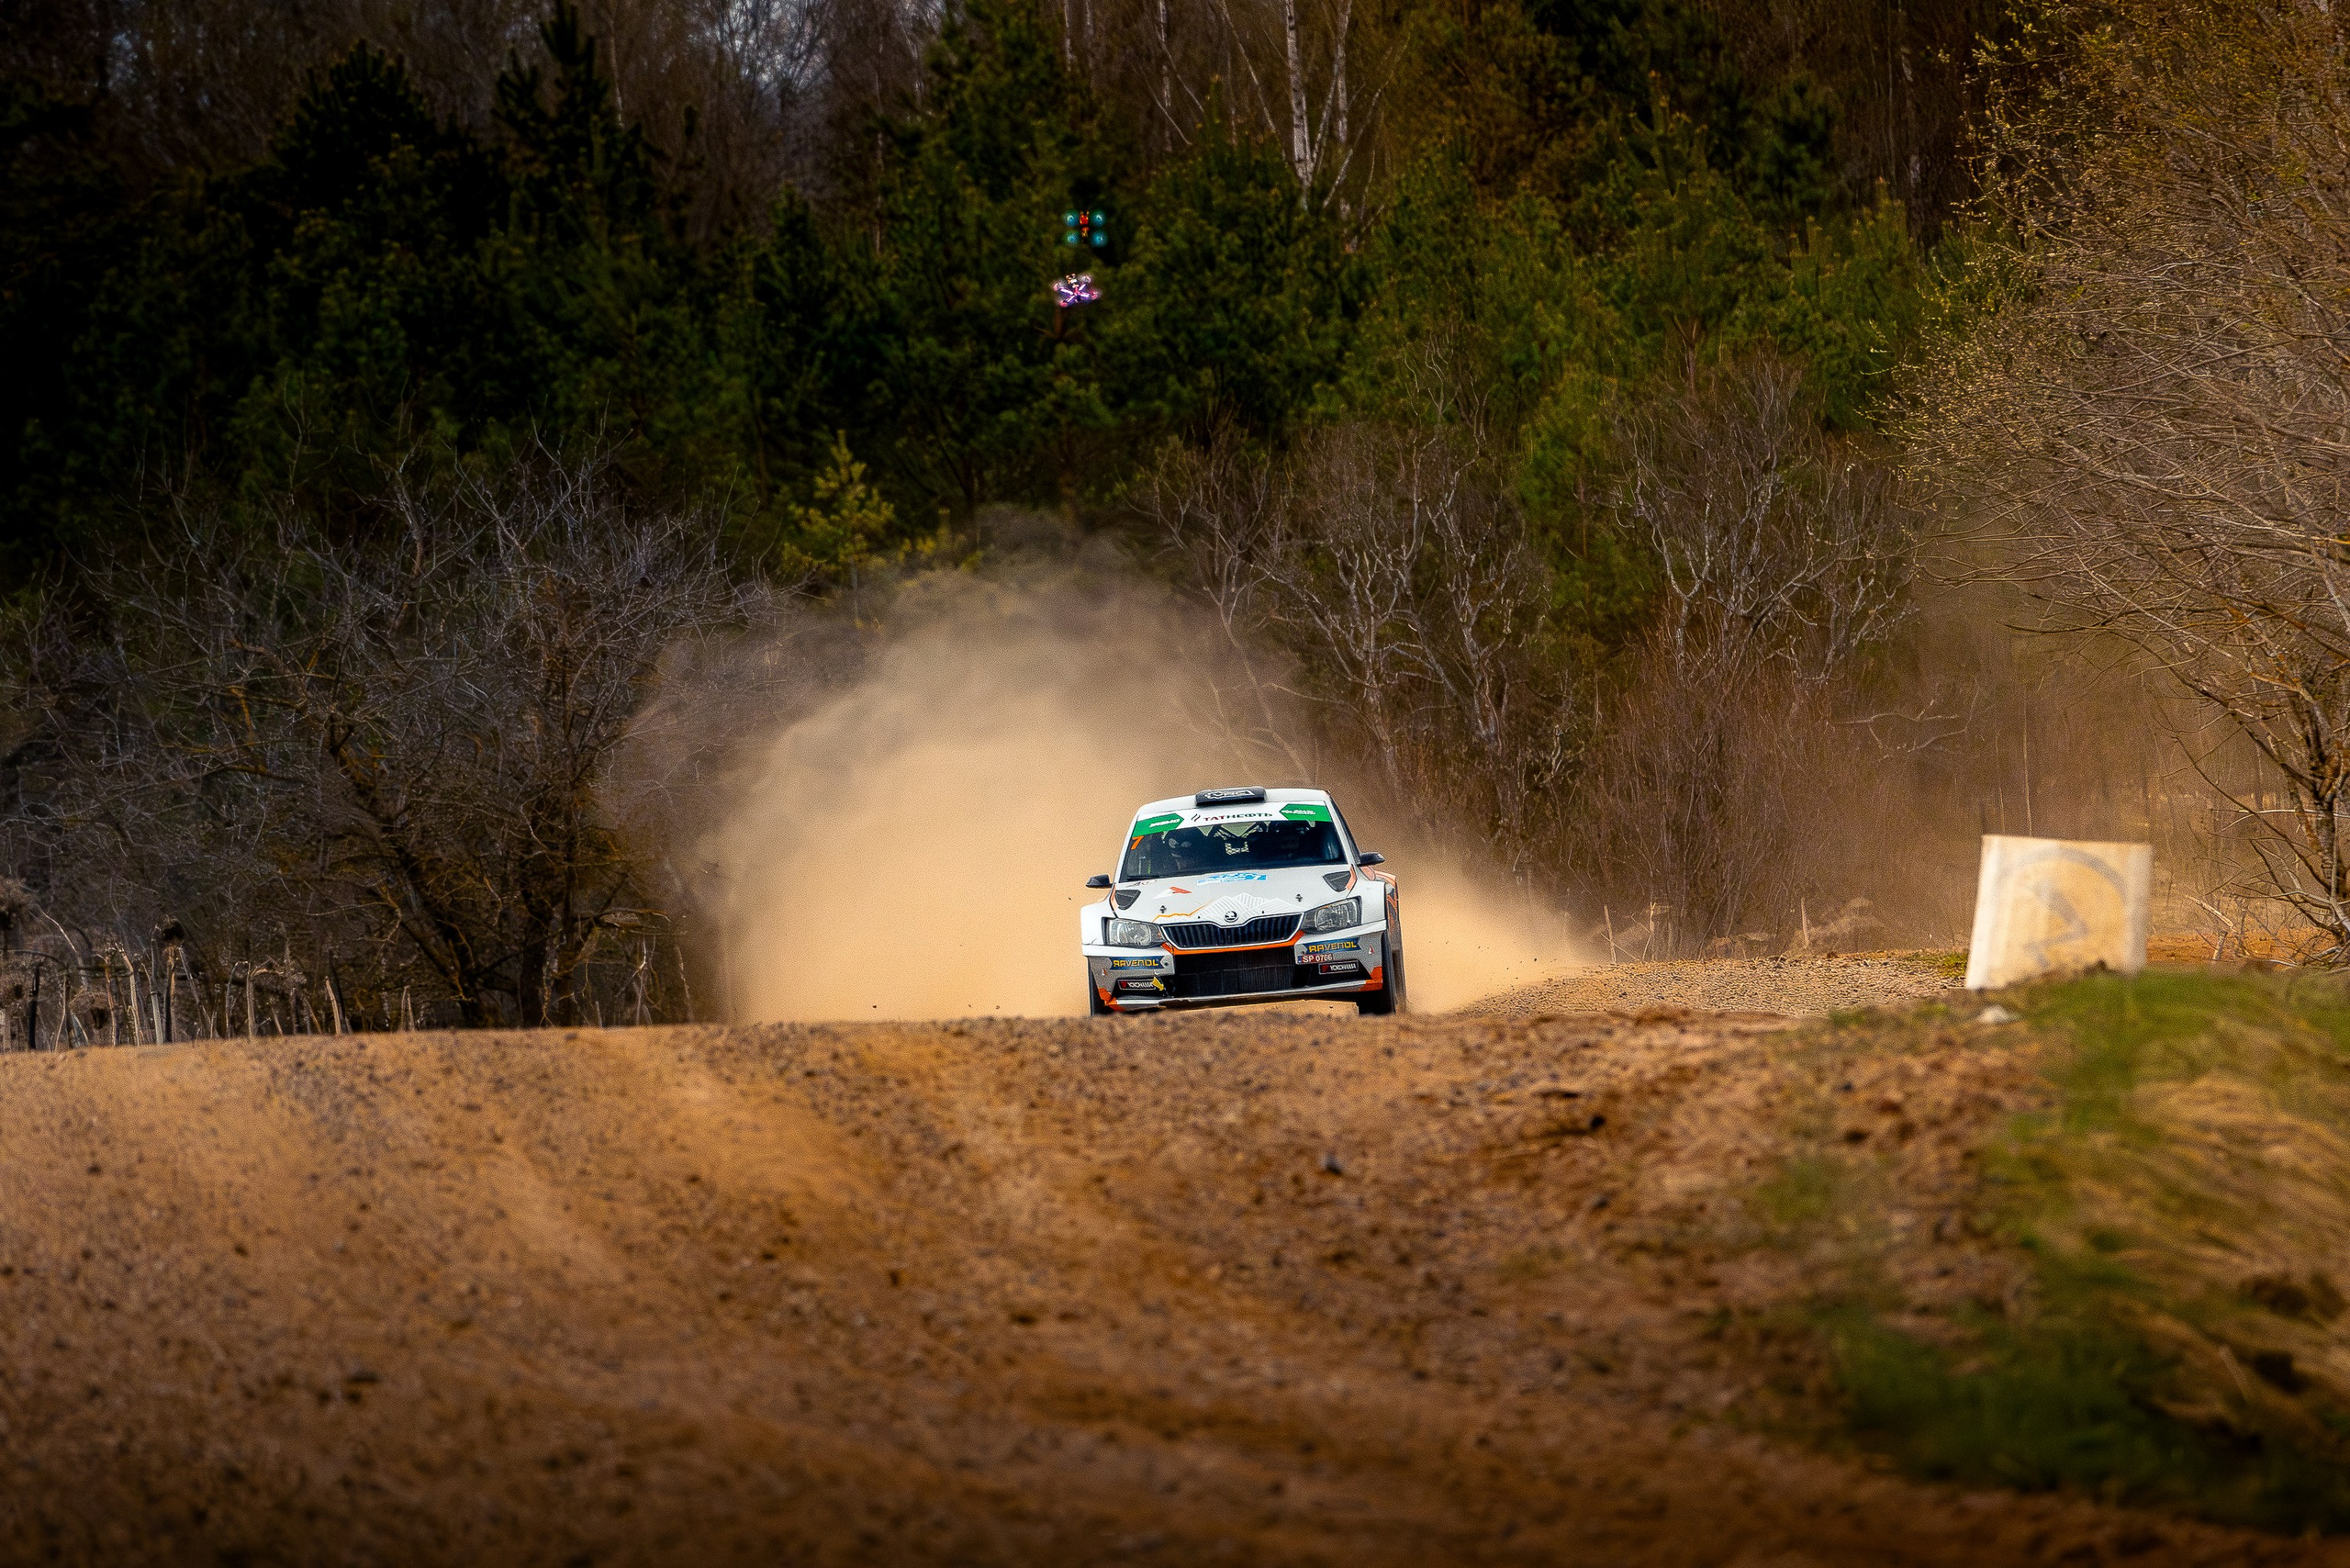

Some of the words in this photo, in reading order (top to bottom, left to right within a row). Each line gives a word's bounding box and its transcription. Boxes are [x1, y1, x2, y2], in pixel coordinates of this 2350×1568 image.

[1130, 835, 1145, 850] 7
[1308, 941, 1358, 953] RAVENOL
[1113, 958, 1159, 968] RAVENOL
